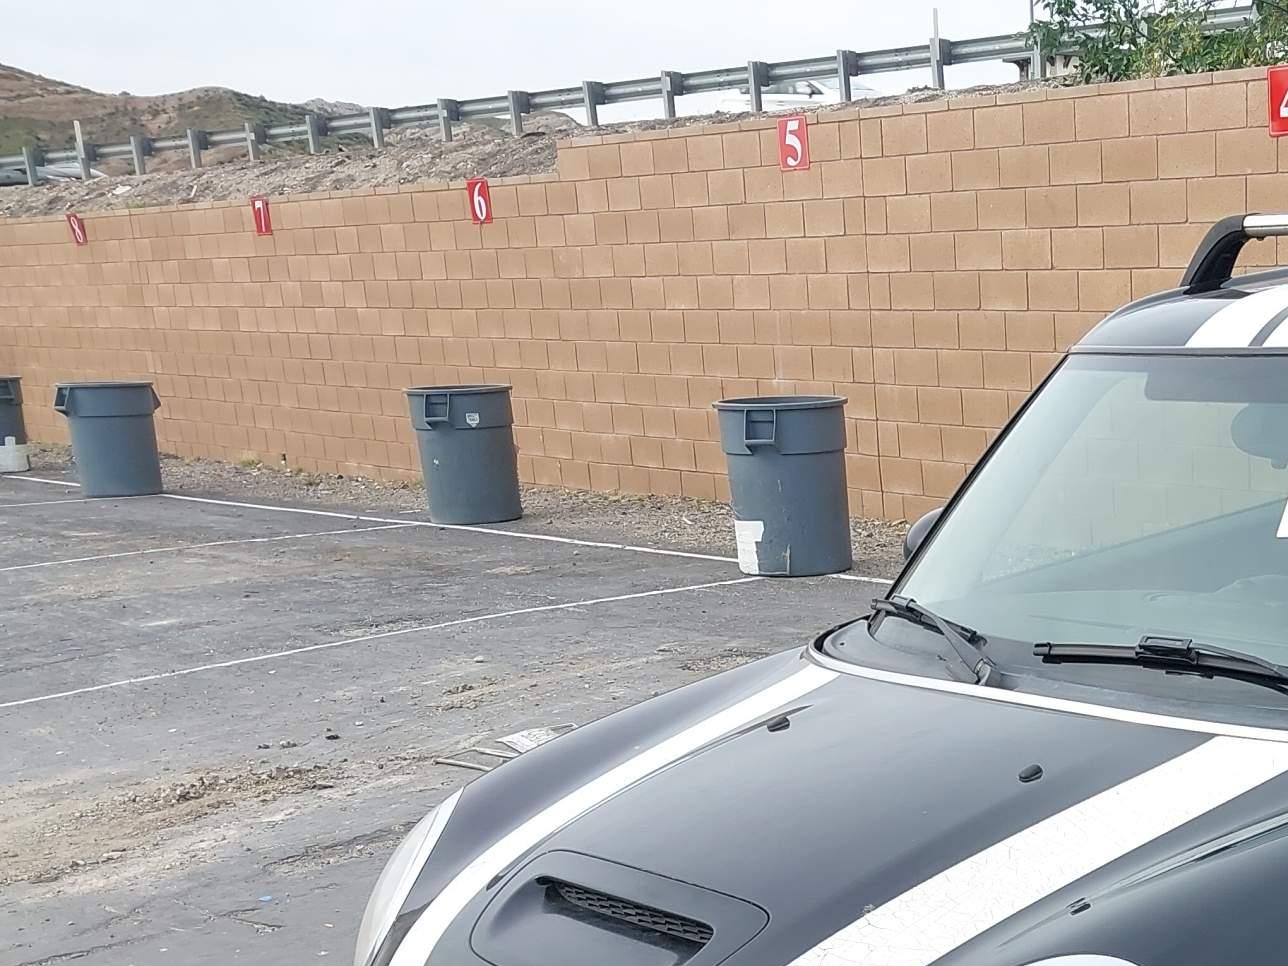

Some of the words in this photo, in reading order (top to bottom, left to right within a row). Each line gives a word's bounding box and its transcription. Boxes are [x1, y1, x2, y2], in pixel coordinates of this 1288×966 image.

[785, 120, 802, 166] 5
[254, 200, 266, 233] 7
[473, 182, 487, 220] 6
[70, 216, 84, 243] 8
